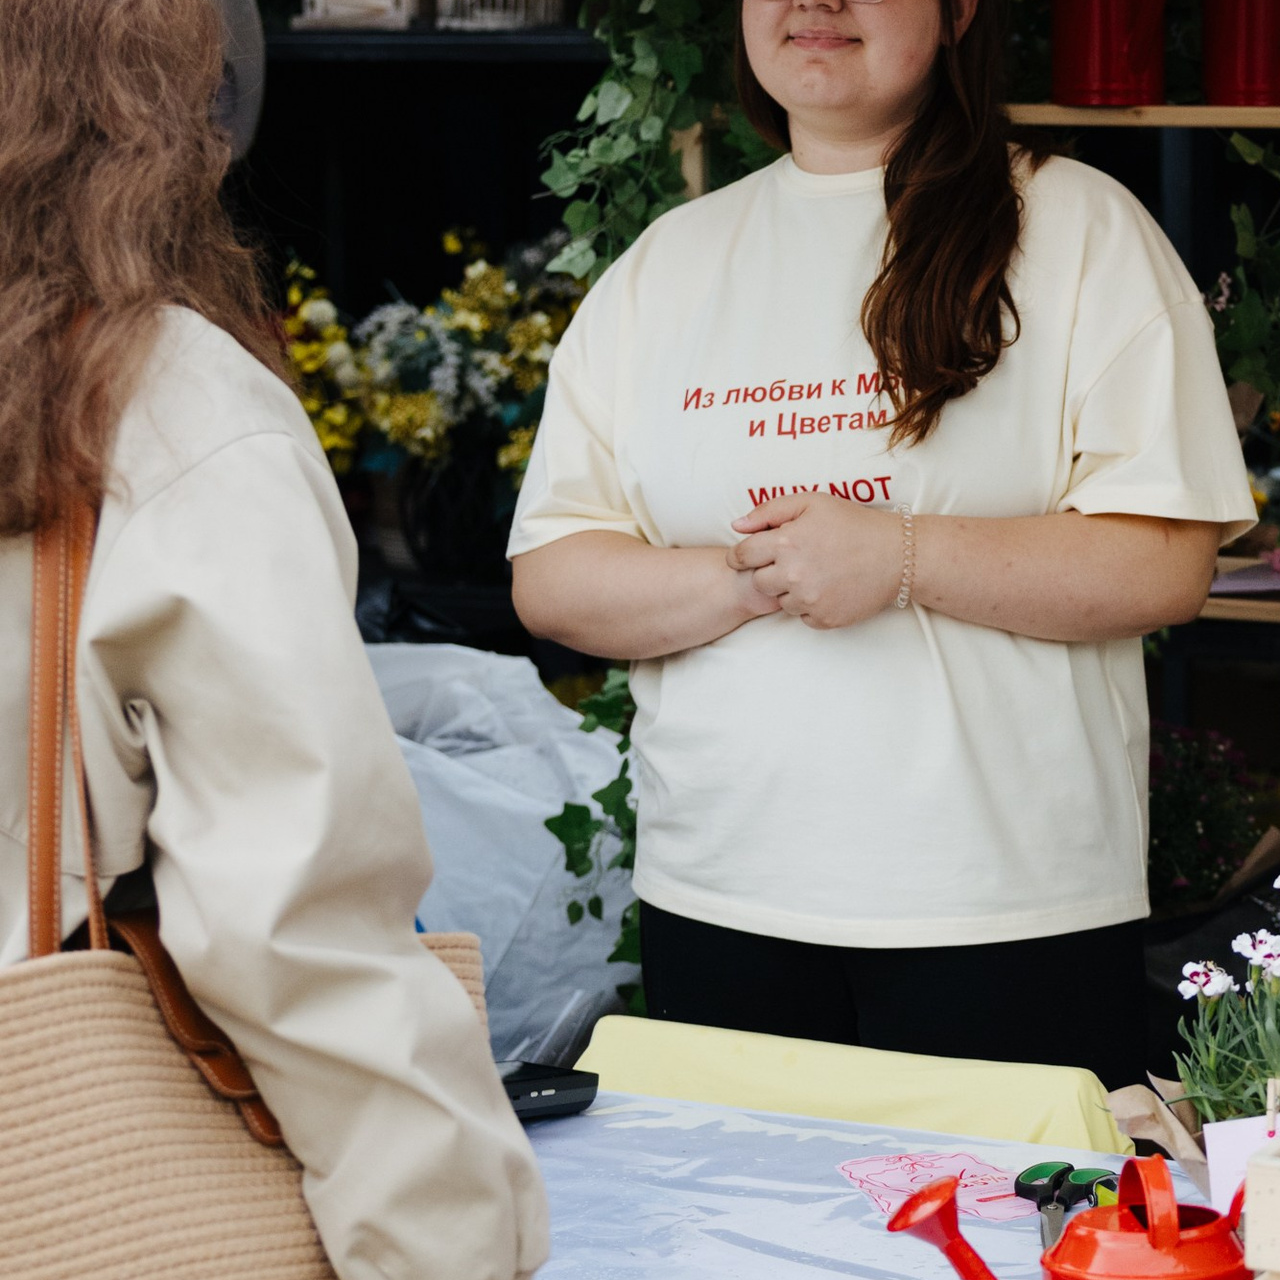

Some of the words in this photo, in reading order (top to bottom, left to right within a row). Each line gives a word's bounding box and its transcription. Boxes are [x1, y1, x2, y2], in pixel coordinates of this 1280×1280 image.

[683, 387, 714, 411] Из
[722, 379, 822, 406] любви
[831, 378, 846, 396] к
[748, 419, 765, 438] и
[777, 409, 888, 440] Цветам
[829, 476, 892, 503] NOT
